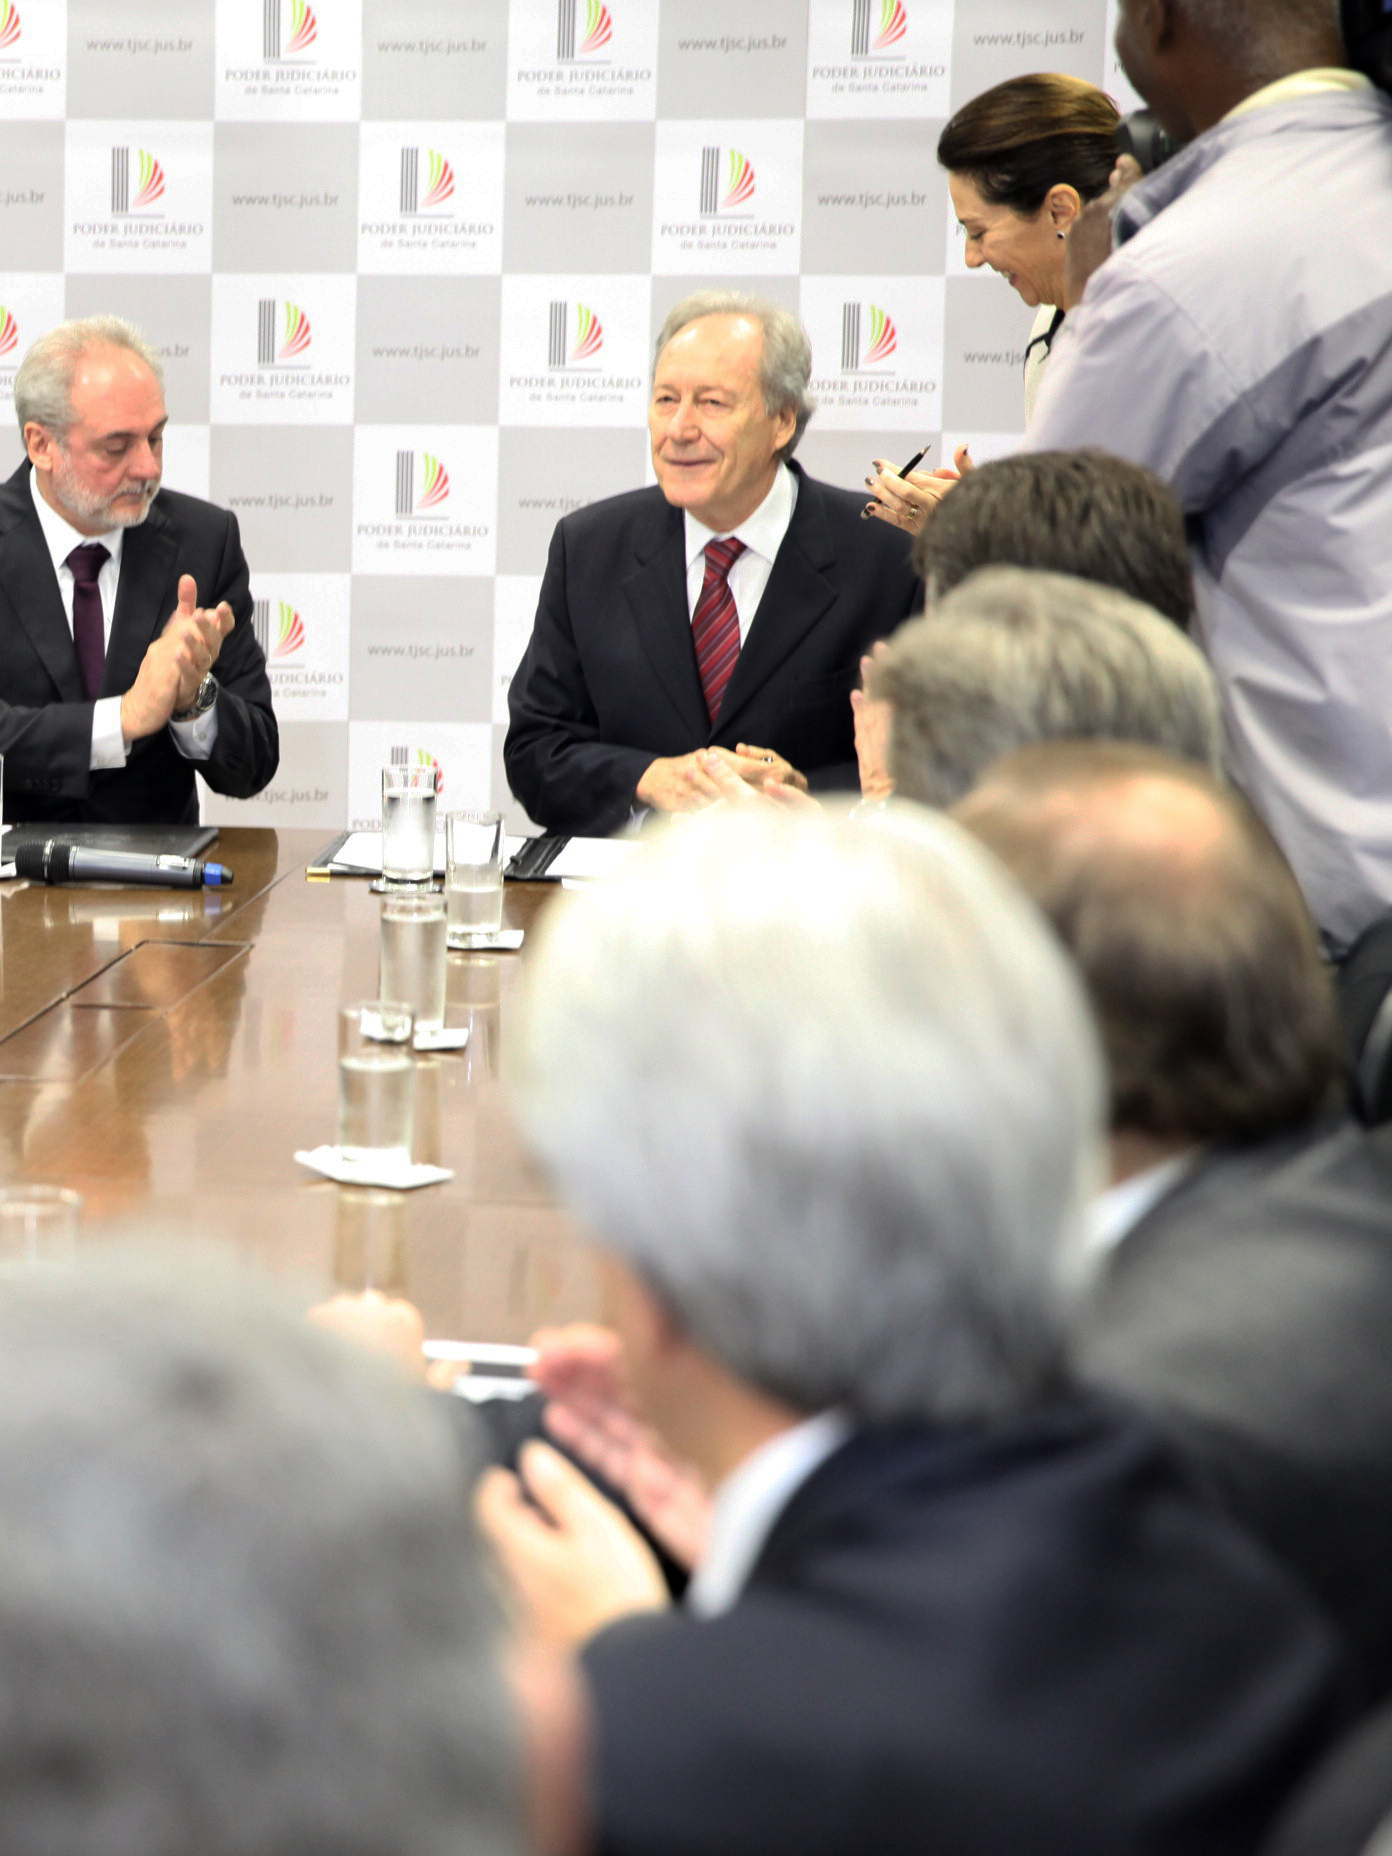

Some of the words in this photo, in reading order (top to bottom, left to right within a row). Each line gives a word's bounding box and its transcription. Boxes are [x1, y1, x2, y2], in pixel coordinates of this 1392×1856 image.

[678, 35, 787, 53] www.tjsc.jus.br
[974, 29, 1085, 47] www.tjsc.jus.br
[86, 38, 193, 54] www.tjsc.jus.br
[378, 40, 487, 55] www.tjsc.jus.br
[225, 68, 270, 78] PODER
[275, 67, 356, 79] JUDICIÁRIO
[517, 68, 563, 81] PODER
[568, 68, 651, 81] JUDICIÁRIO
[812, 66, 858, 79] PODER
[862, 62, 944, 78] JUDICIÁRIO
[232, 193, 339, 208] www.tjsc.jus.br
[525, 192, 634, 209] www.tjsc.jus.br
[818, 191, 927, 209] www.tjsc.jus.br
[73, 223, 118, 235] PODER
[123, 222, 204, 235] JUDICIÁRIO
[361, 224, 407, 235] PODER
[411, 222, 493, 236] JUDICIÁRIO
[661, 224, 707, 236] PODER
[712, 222, 795, 236] JUDICIÁRIO
[372, 344, 481, 360] www.tjsc.jus.br
[220, 374, 265, 386] PODER
[270, 373, 351, 387] JUDICIÁRIO
[509, 376, 555, 387] PODER
[559, 375, 642, 388] JUDICIÁRIO
[853, 379, 937, 393] JUDICIÁRIO
[229, 493, 334, 510] www.tjsc.jus.br
[357, 525, 403, 536] PODER
[407, 524, 489, 537] JUDICIÁRIO
[368, 644, 475, 659] www.tjsc.jus.br
[271, 671, 343, 685] UDICIÁRIO
[225, 789, 329, 803] .tjsc.jus.br
[352, 819, 382, 830] POD
